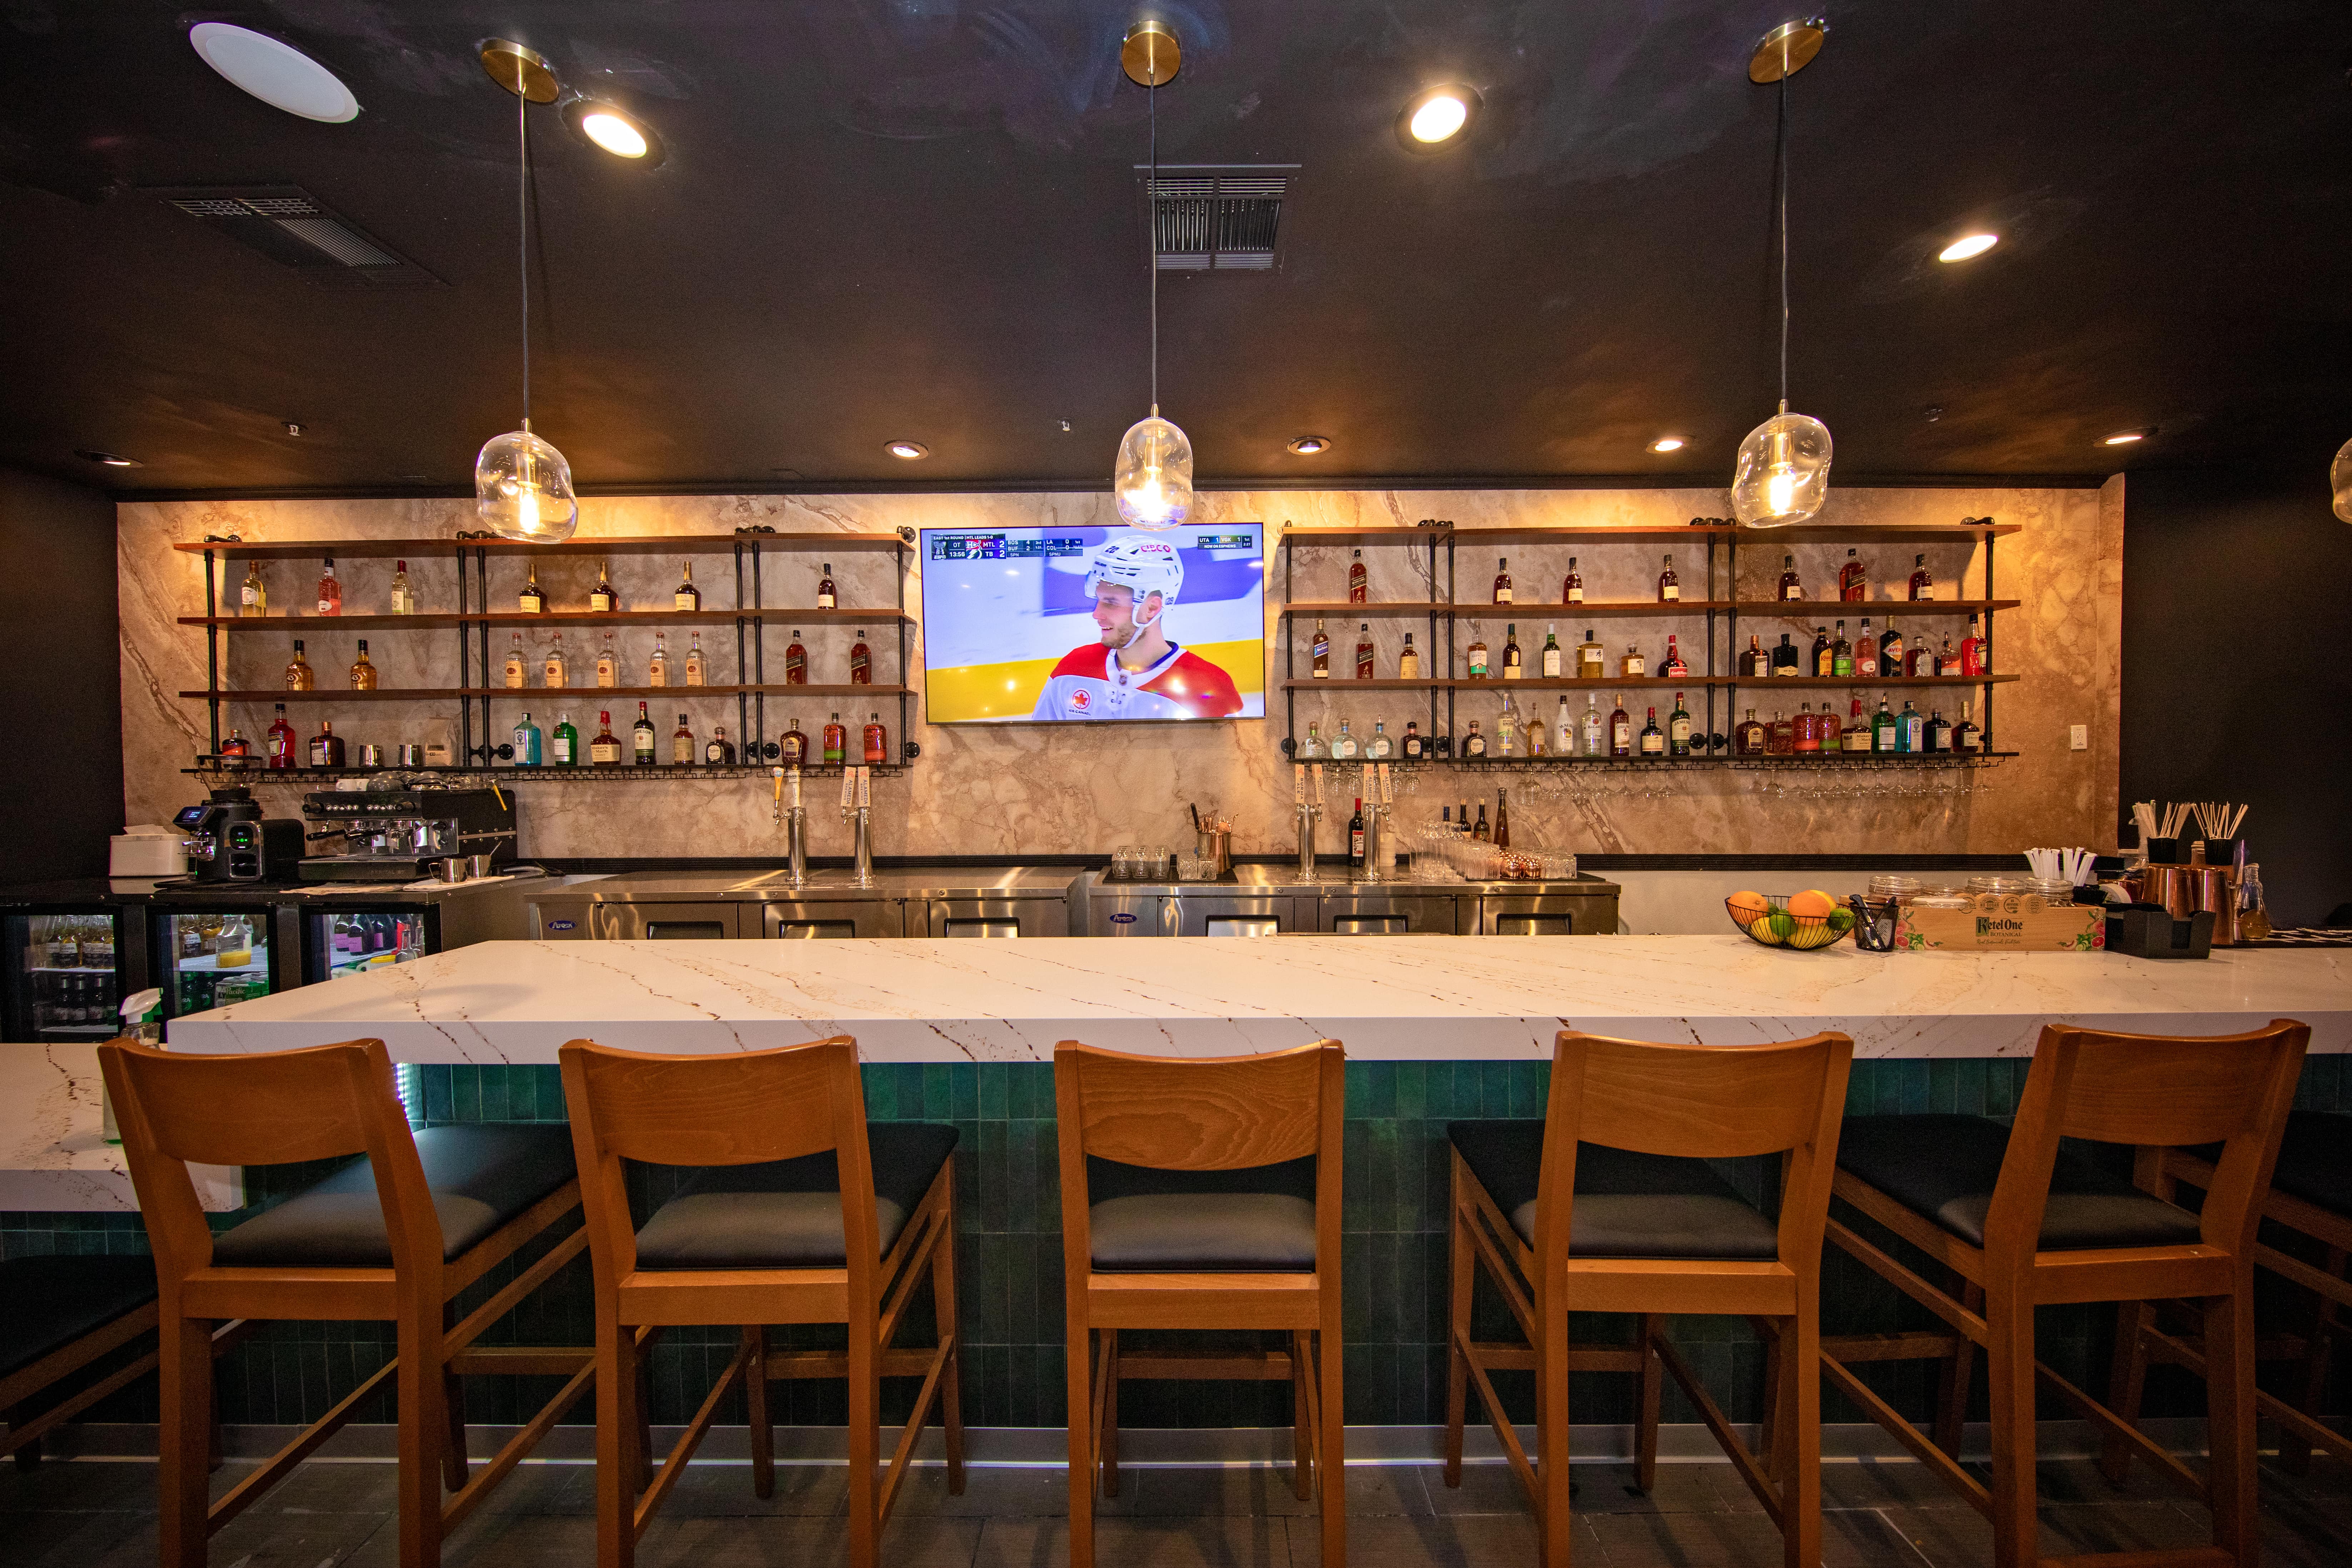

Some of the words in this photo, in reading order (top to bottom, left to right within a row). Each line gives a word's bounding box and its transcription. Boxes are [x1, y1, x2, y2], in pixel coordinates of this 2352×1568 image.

[1977, 918, 2003, 935] Ketel
[2004, 919, 2023, 930] One
[226, 987, 246, 995] Pacific
